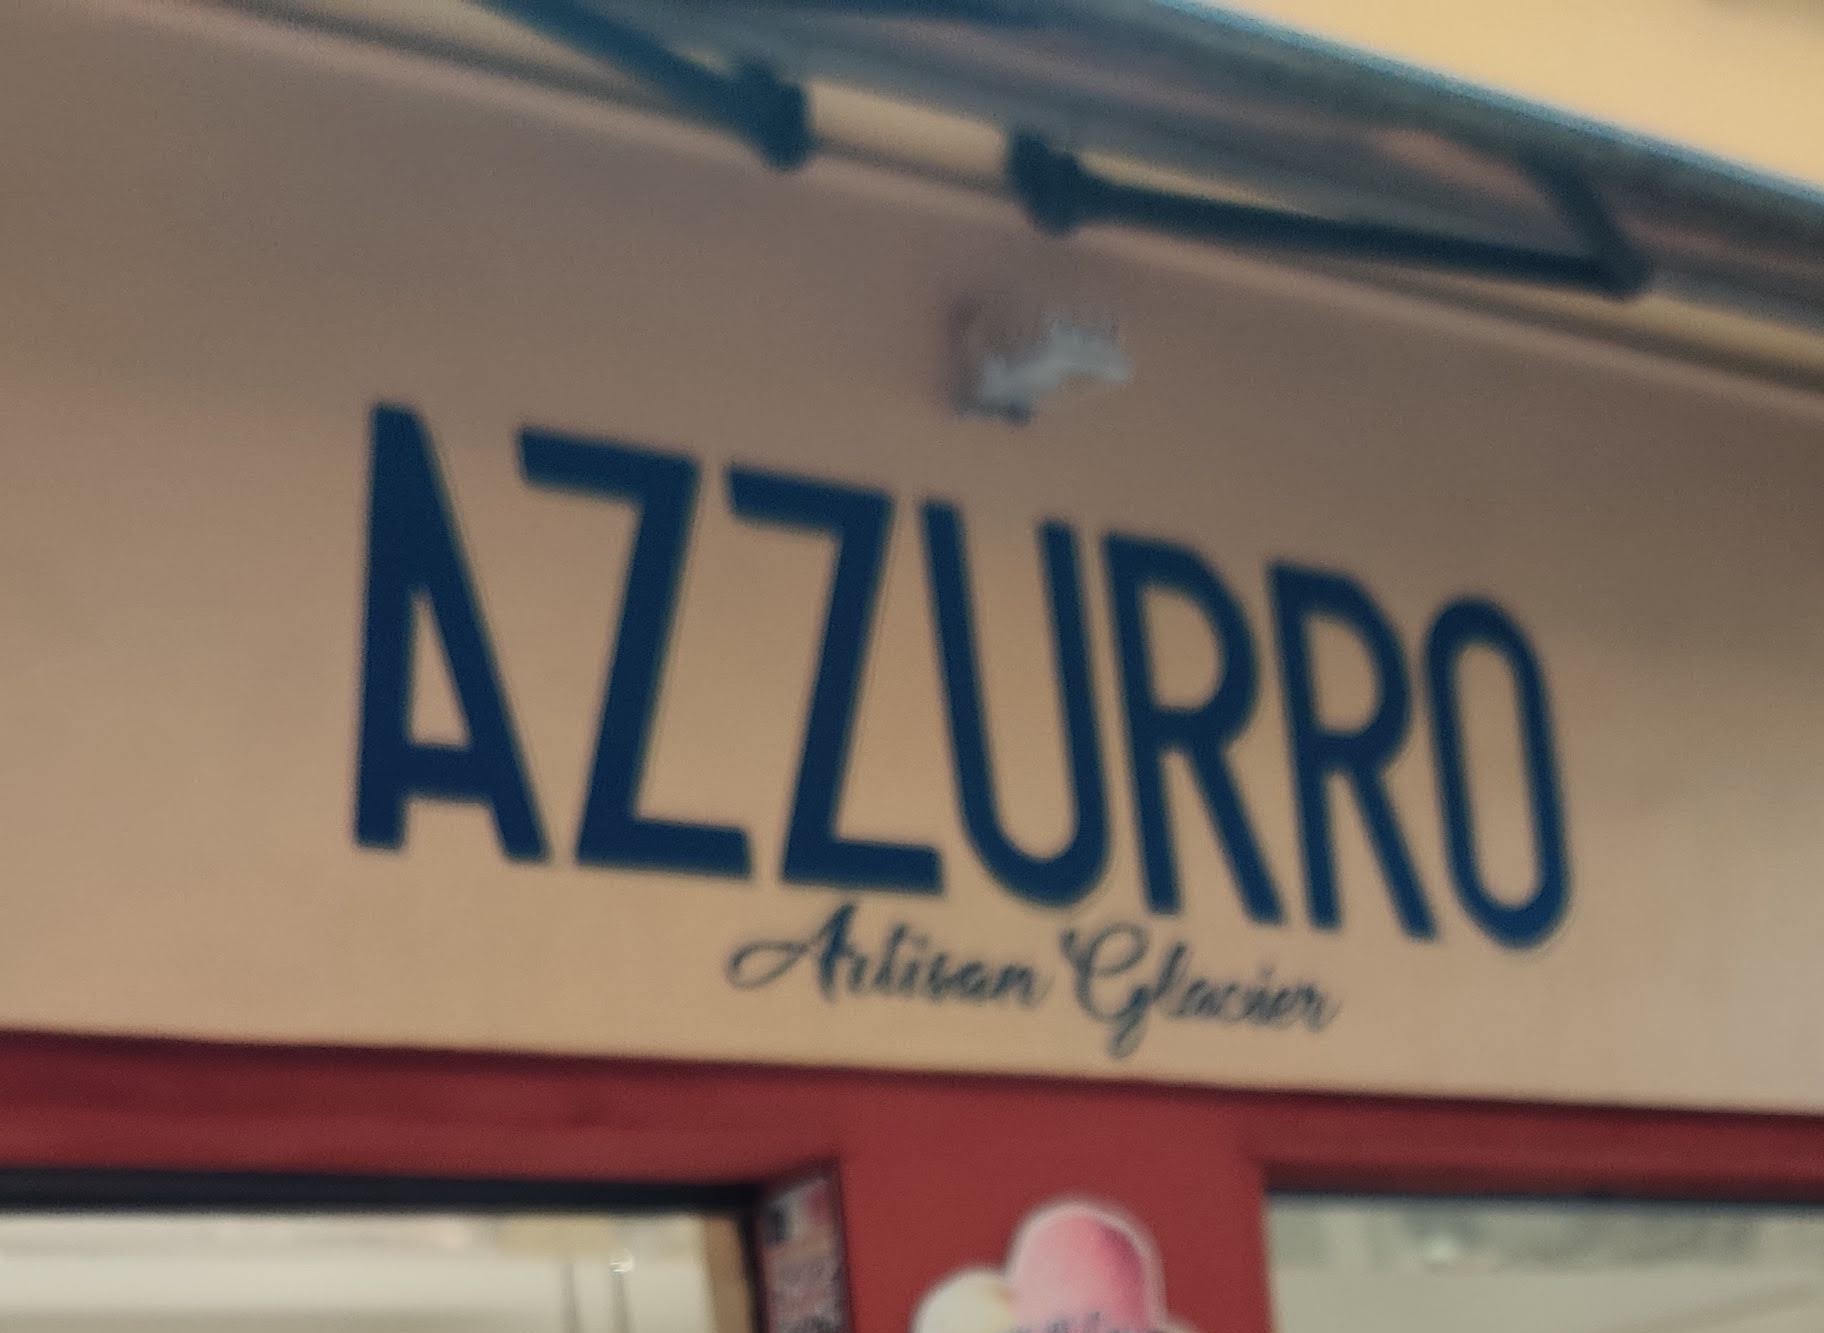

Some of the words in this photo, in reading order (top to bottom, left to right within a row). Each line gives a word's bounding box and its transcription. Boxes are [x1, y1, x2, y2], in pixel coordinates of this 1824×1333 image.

[354, 402, 1570, 948] AZZURRO
[726, 903, 1050, 1001] Artisan
[1061, 922, 1338, 1058] Glacier
